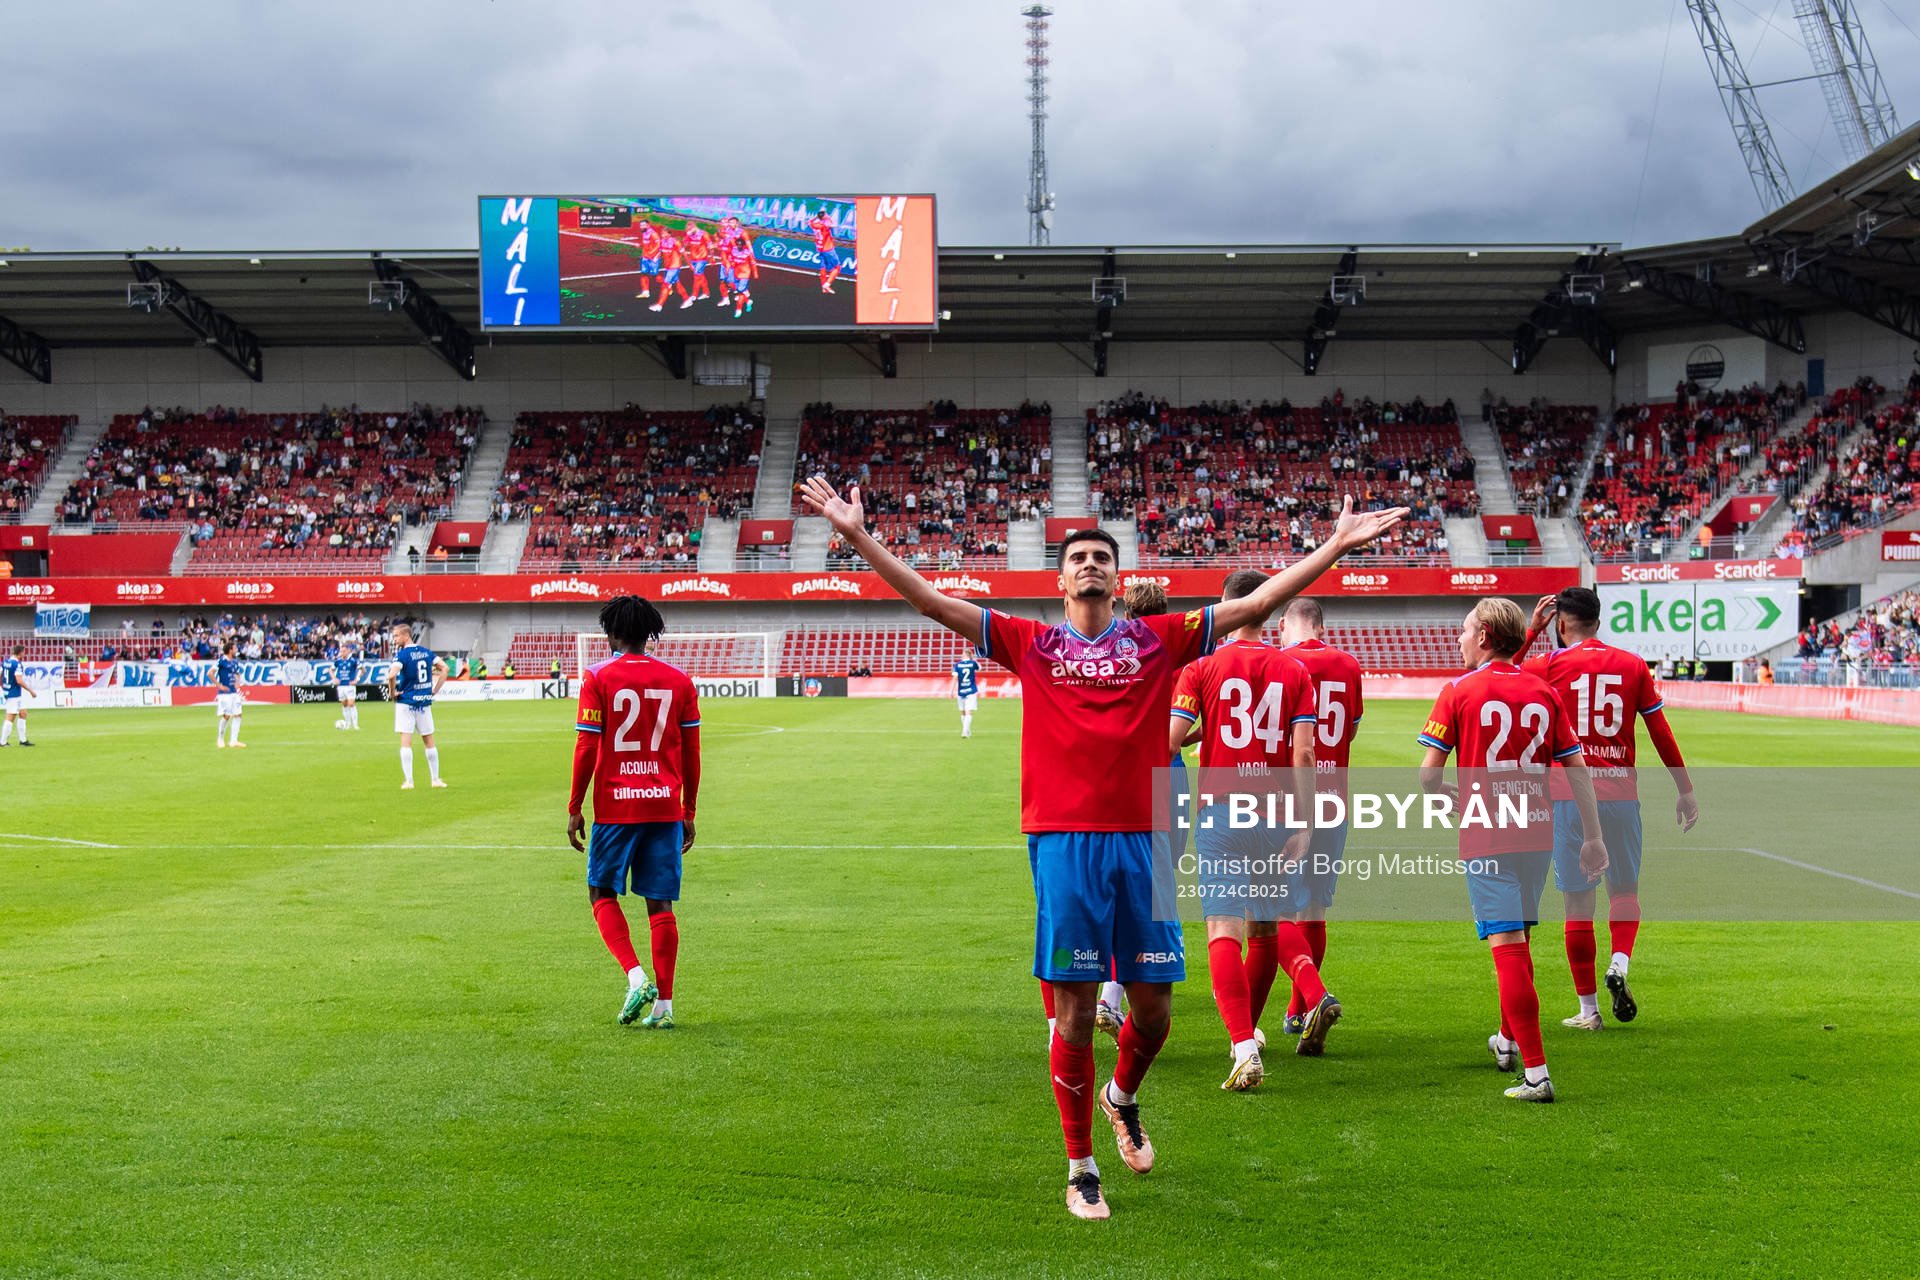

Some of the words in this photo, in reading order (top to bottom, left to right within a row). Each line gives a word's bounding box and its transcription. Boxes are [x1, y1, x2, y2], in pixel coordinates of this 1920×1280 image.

[1621, 563, 1680, 581] Scandic
[1714, 560, 1775, 579] Scandic
[227, 580, 260, 594] akea
[337, 580, 370, 593] akea
[661, 577, 729, 596] RAMLÖSA
[792, 576, 860, 595] RAMLÖSA
[1342, 573, 1374, 585] akea
[1451, 572, 1483, 585] akea
[8, 582, 41, 595] akea
[117, 581, 150, 595] akea
[530, 578, 599, 597] RAMLÖSA
[39, 608, 85, 630] TIFO
[1610, 589, 1726, 633] akea
[1717, 644, 1758, 653] ELEDA
[417, 660, 428, 683] 6
[962, 668, 971, 682] 2
[1051, 660, 1115, 677] akea
[696, 680, 759, 697] mobil
[1312, 680, 1346, 747] 5
[1570, 673, 1624, 738] 15
[613, 688, 673, 752] 27
[1219, 677, 1284, 754] 34
[1480, 700, 1550, 774] 22
[1580, 743, 1627, 760] LYAMAWI
[620, 761, 659, 775] ACQUAH
[613, 786, 671, 800] tillmobil
[1074, 949, 1099, 961] Solid
[1143, 952, 1178, 963] RSA
